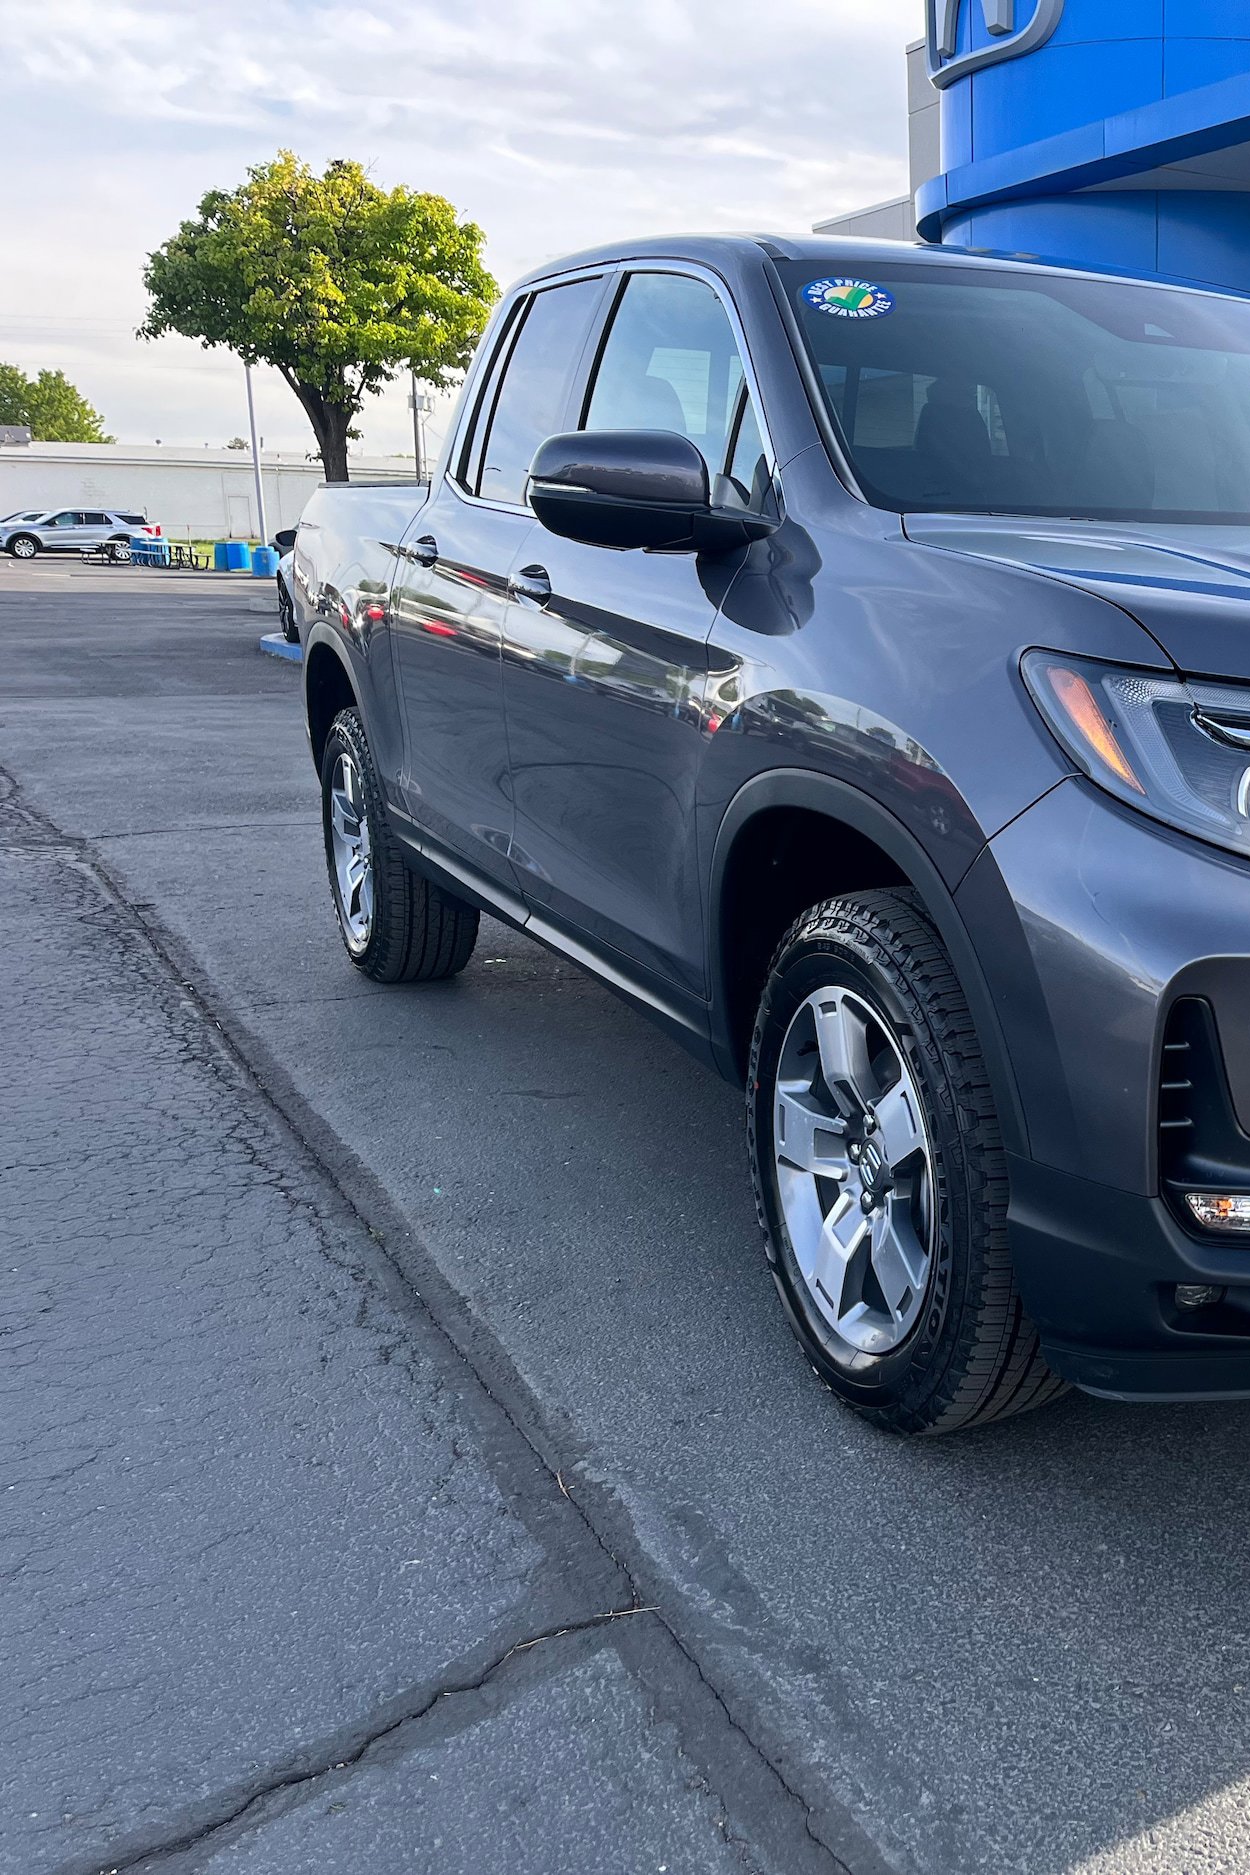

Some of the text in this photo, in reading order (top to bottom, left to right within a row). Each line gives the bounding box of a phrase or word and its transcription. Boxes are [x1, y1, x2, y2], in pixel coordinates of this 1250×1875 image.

[807, 279, 878, 296] BEST PRICE
[818, 299, 892, 318] GUARANTEE
